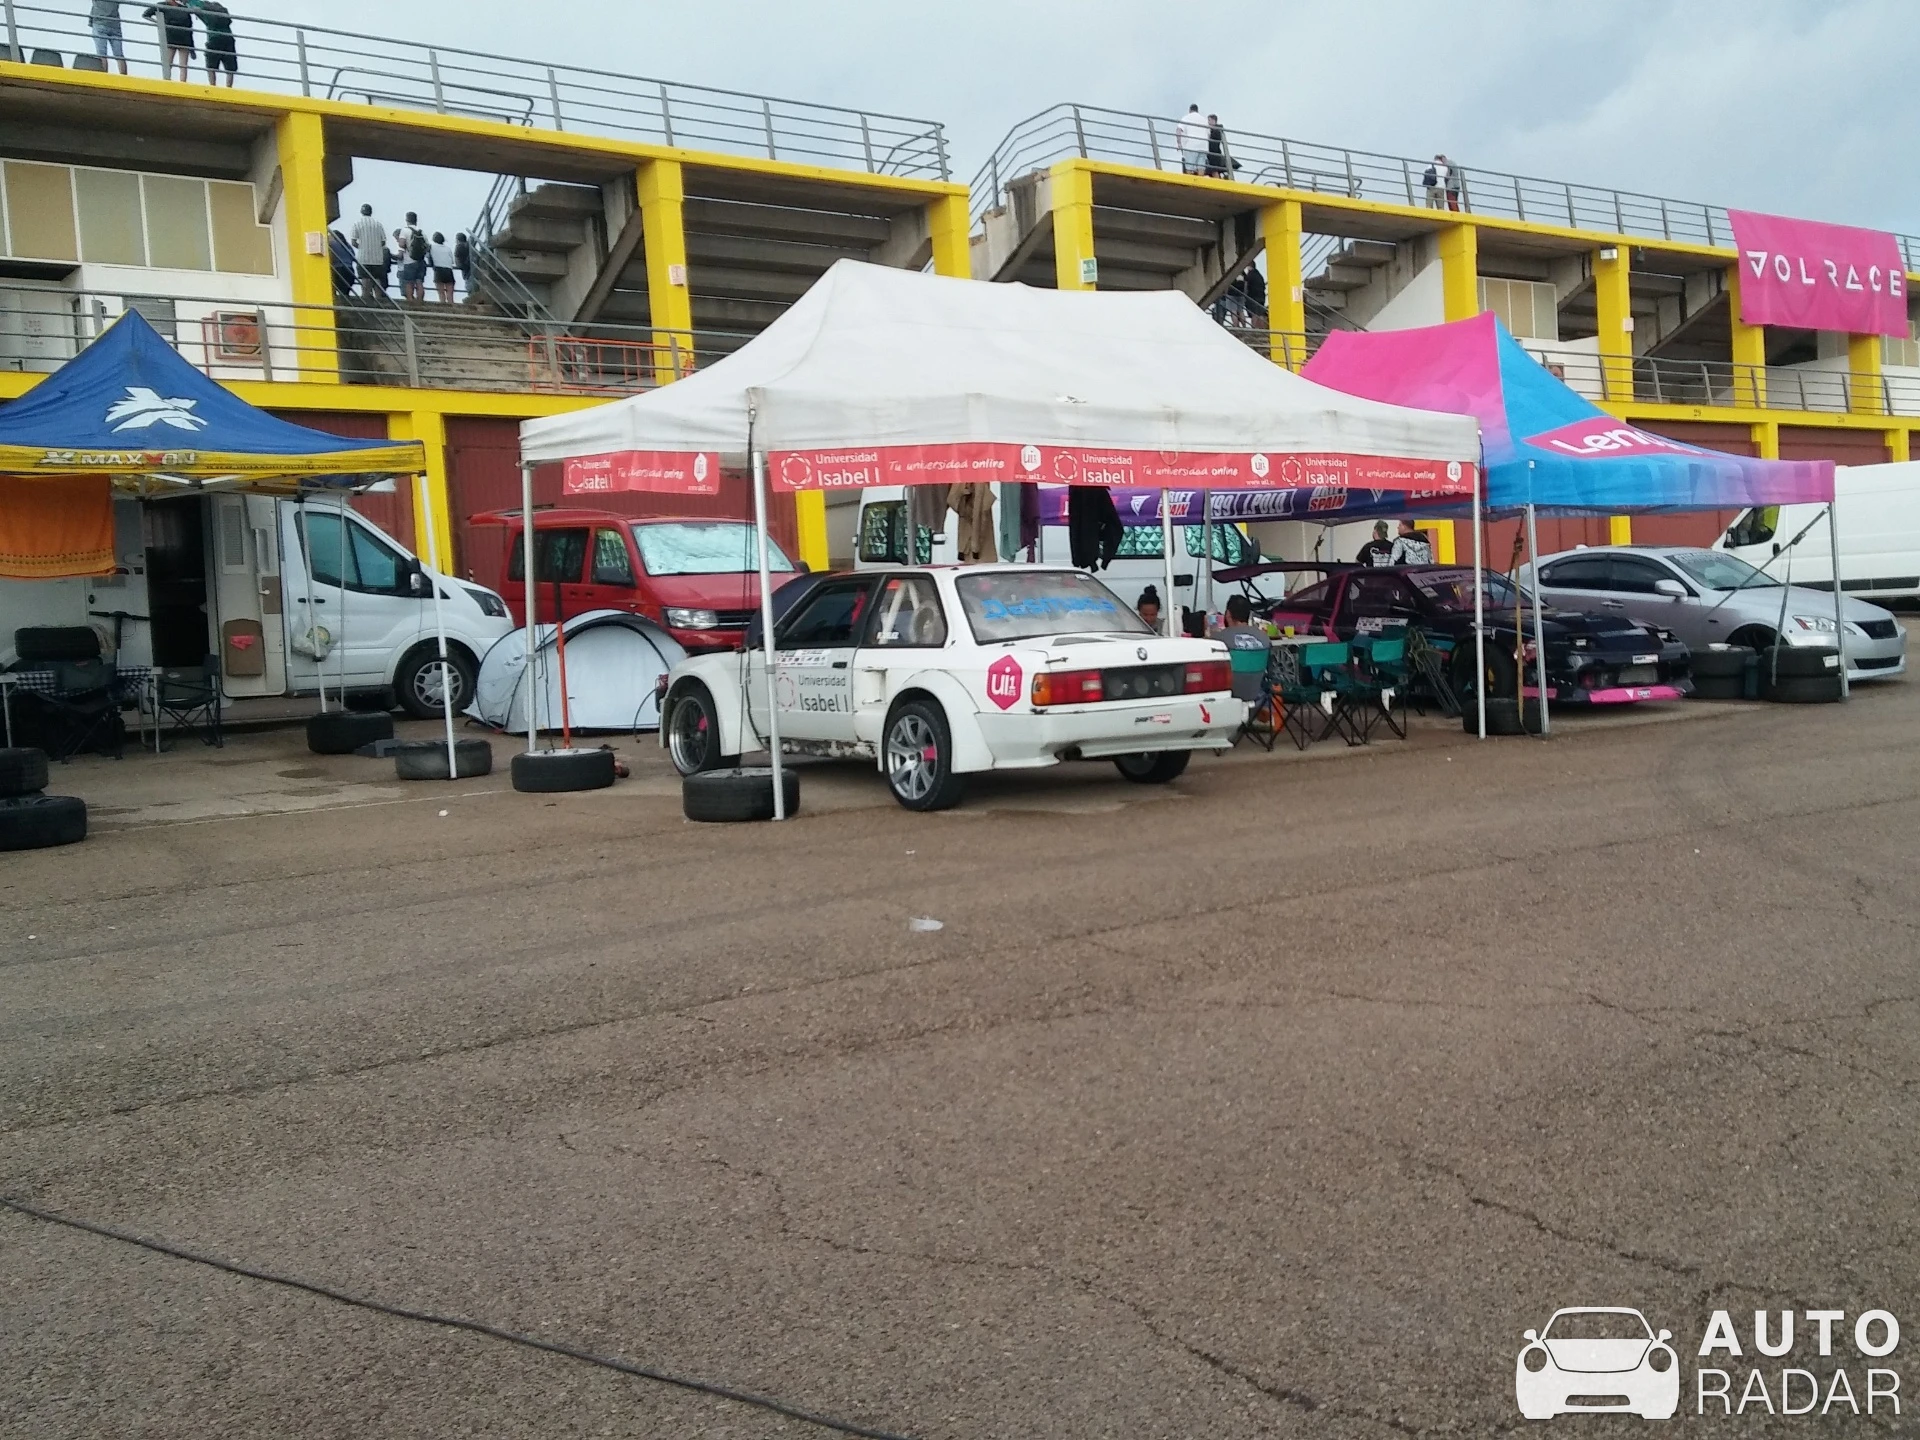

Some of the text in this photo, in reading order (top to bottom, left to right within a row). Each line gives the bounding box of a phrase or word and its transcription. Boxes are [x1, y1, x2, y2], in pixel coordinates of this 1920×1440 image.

[81, 452, 195, 465] MAXXON
[815, 452, 878, 464] Universidad
[889, 458, 1005, 471] Tu universidad online
[1082, 454, 1132, 465] Universidad
[1305, 457, 1348, 468] Universidad
[818, 467, 880, 486] Isabel I
[1083, 468, 1134, 484] Isabel I
[1142, 465, 1238, 476] Tu universidad online
[1355, 468, 1436, 480] Tu universidad online
[1306, 470, 1348, 485] Isabel I
[1157, 503, 1188, 516] SAIN
[1309, 495, 1346, 511] SPAIN
[799, 675, 846, 687] Universidad
[800, 693, 841, 712] Isabel
